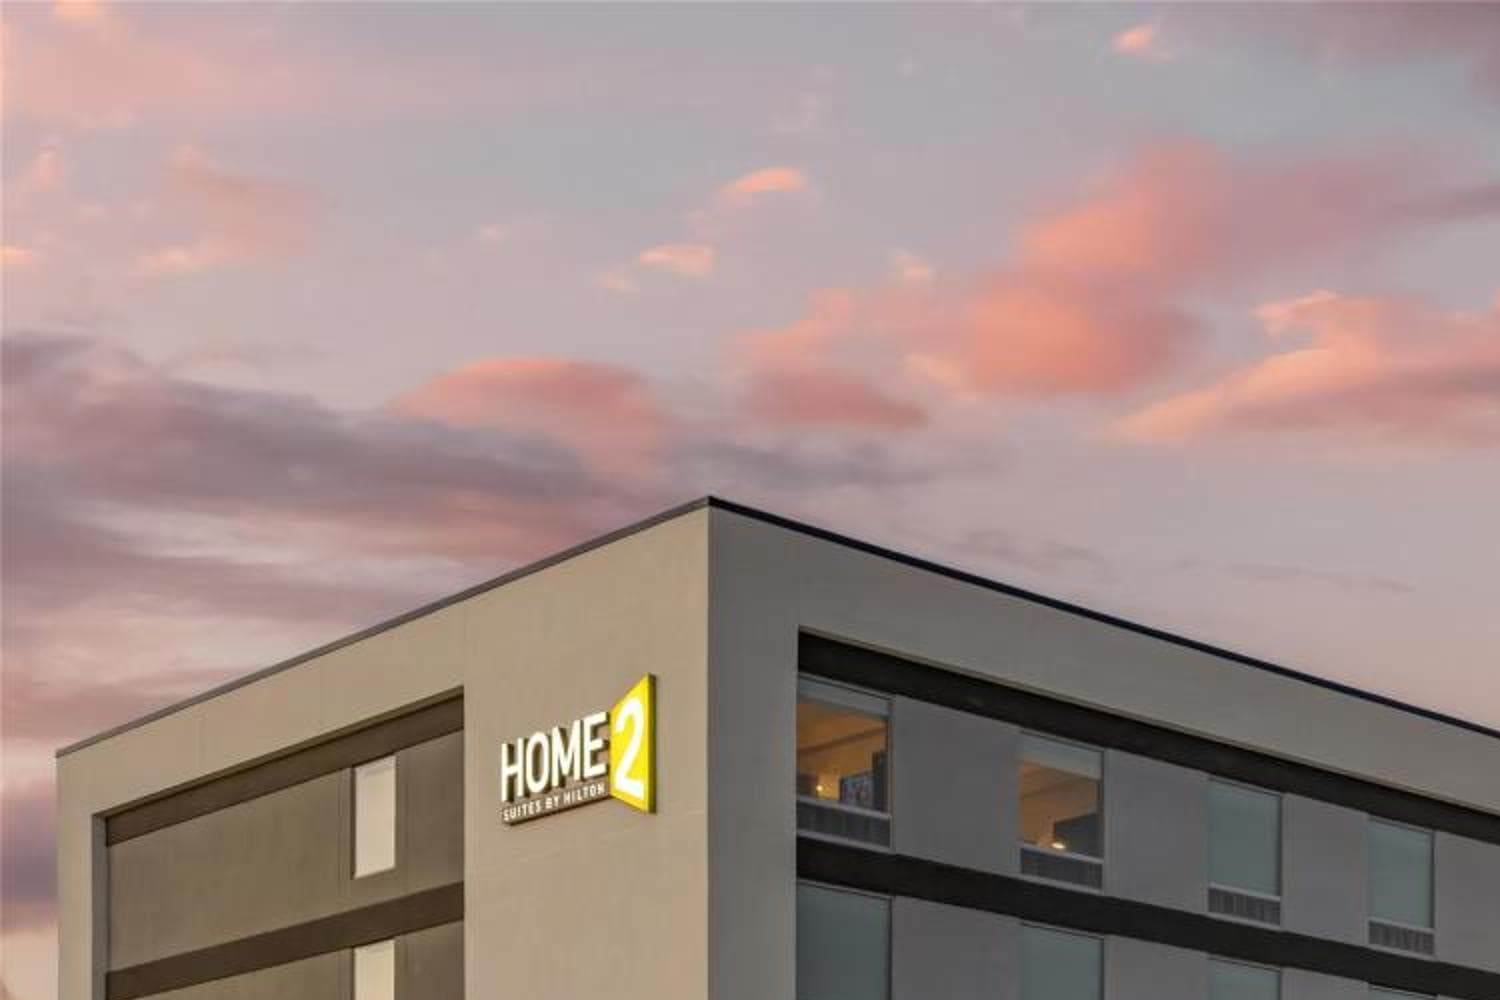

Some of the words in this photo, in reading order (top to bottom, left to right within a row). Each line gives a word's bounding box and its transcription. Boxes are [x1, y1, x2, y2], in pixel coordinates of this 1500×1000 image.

[501, 711, 608, 802] HOME
[614, 697, 646, 801] 2
[503, 799, 542, 821] SUITES
[545, 795, 560, 810] BY
[563, 783, 605, 806] HILTON
